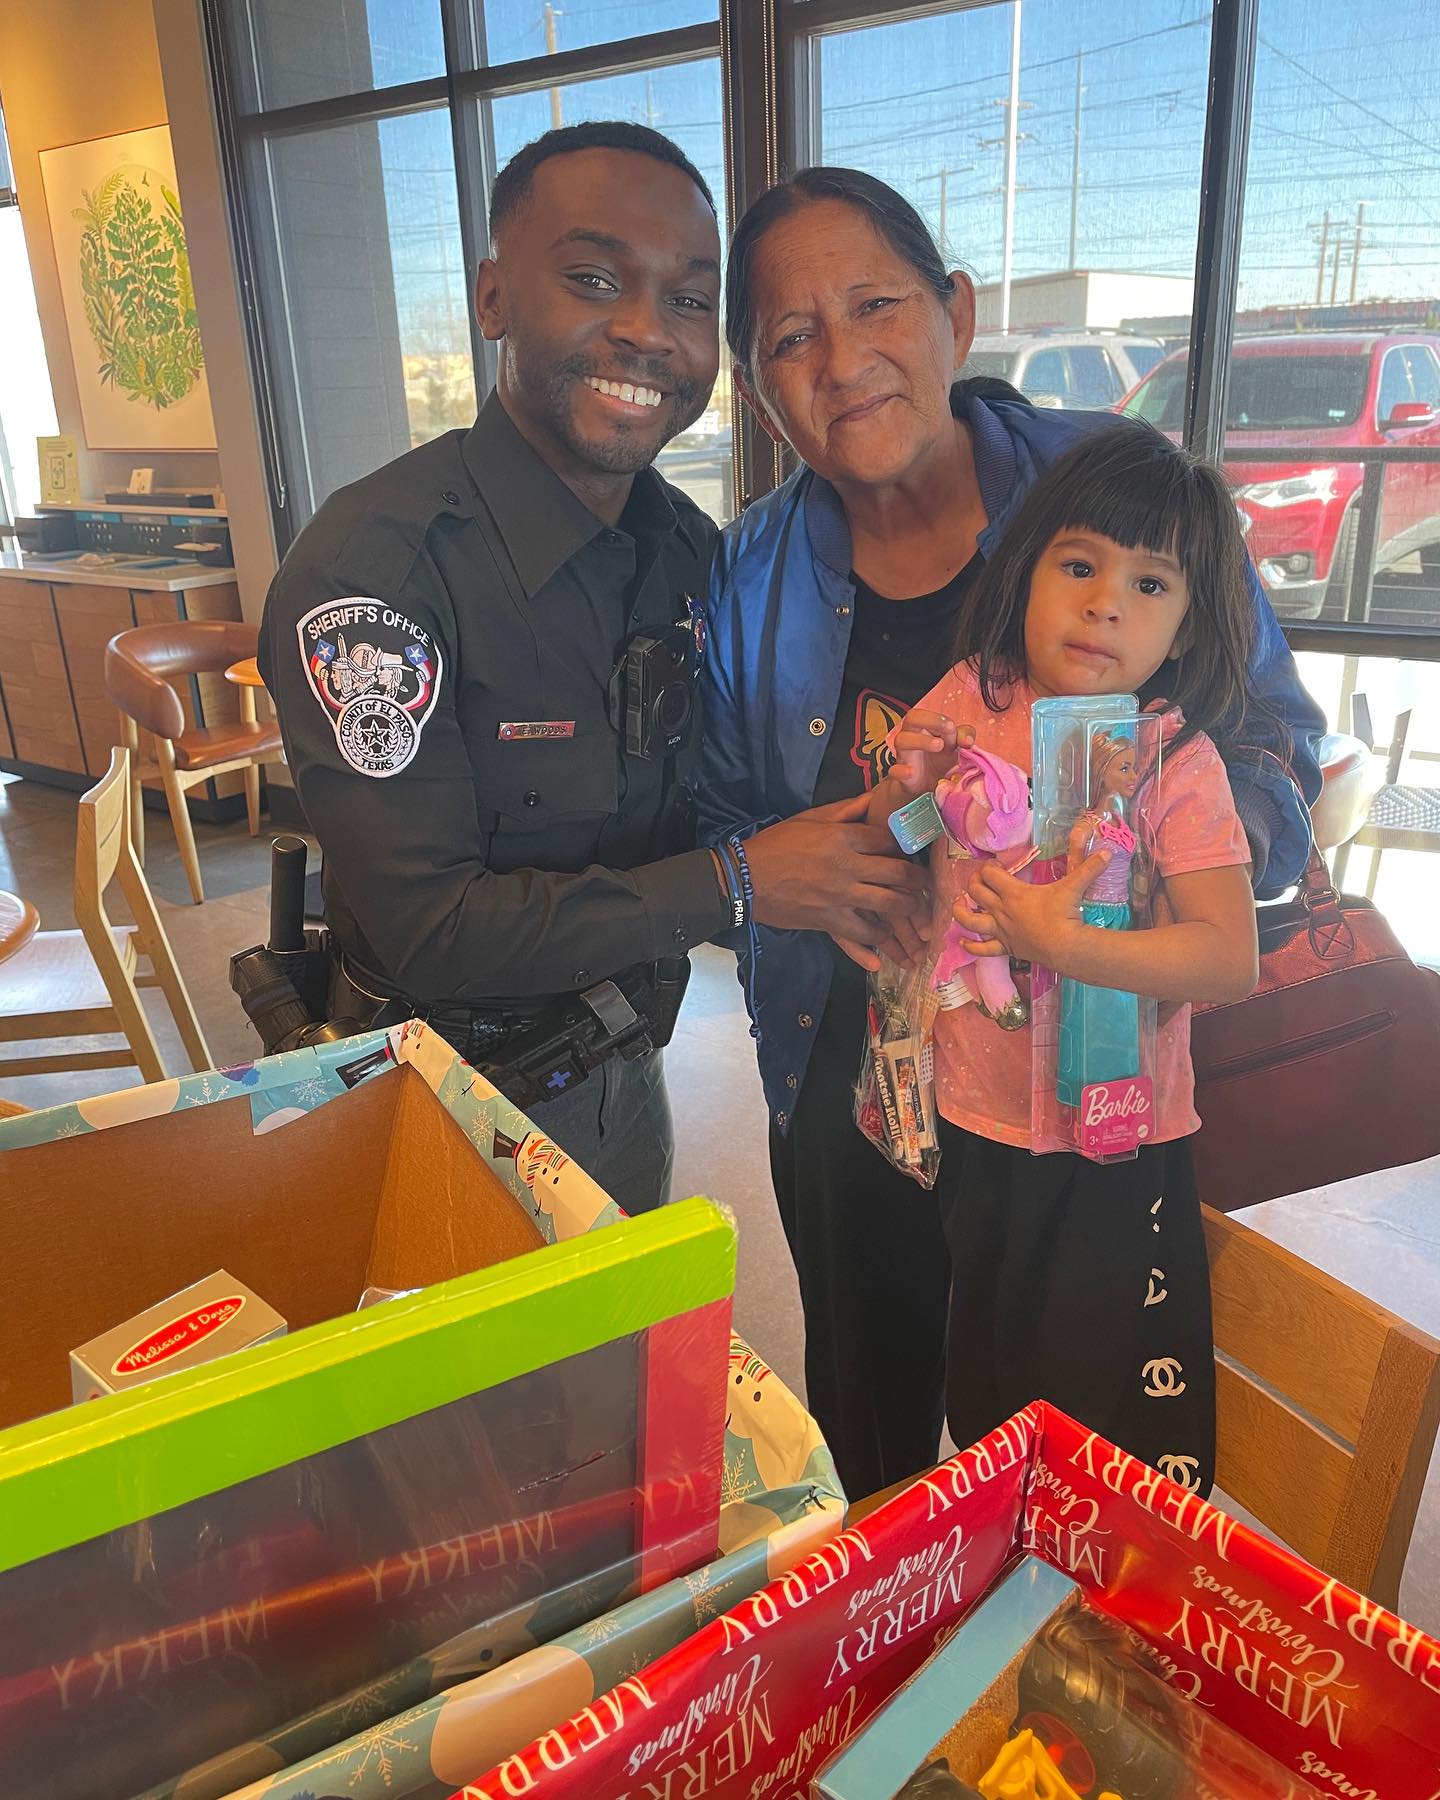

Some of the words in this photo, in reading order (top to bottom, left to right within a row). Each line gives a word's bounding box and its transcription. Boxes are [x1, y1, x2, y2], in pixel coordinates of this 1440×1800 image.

[307, 605, 378, 640] SHERIFF'S
[382, 609, 430, 648] OFFICE
[341, 704, 364, 737] COUNTY
[365, 702, 377, 713] of
[380, 703, 392, 717] EL
[393, 710, 412, 739] PASO
[361, 758, 394, 771] TEXAS
[734, 899, 744, 922] PRAY
[875, 1056, 892, 1106] Tootsie
[885, 1105, 902, 1137] Roll
[1085, 1084, 1150, 1127] Barbie
[1089, 1135, 1099, 1146] 3+
[125, 1330, 188, 1367] Melissa
[188, 1321, 199, 1332] &
[198, 1303, 237, 1324] Doug
[927, 1406, 1038, 1522] MERRY
[1067, 1432, 1241, 1562] MERRY
[721, 1528, 876, 1656] MERRY
[844, 1525, 973, 1621] Christmas
[824, 1560, 967, 1689] MERRY
[1189, 1565, 1360, 1689] Christmas
[623, 1654, 773, 1777] Christmas
[1163, 1596, 1349, 1750] MERRY
